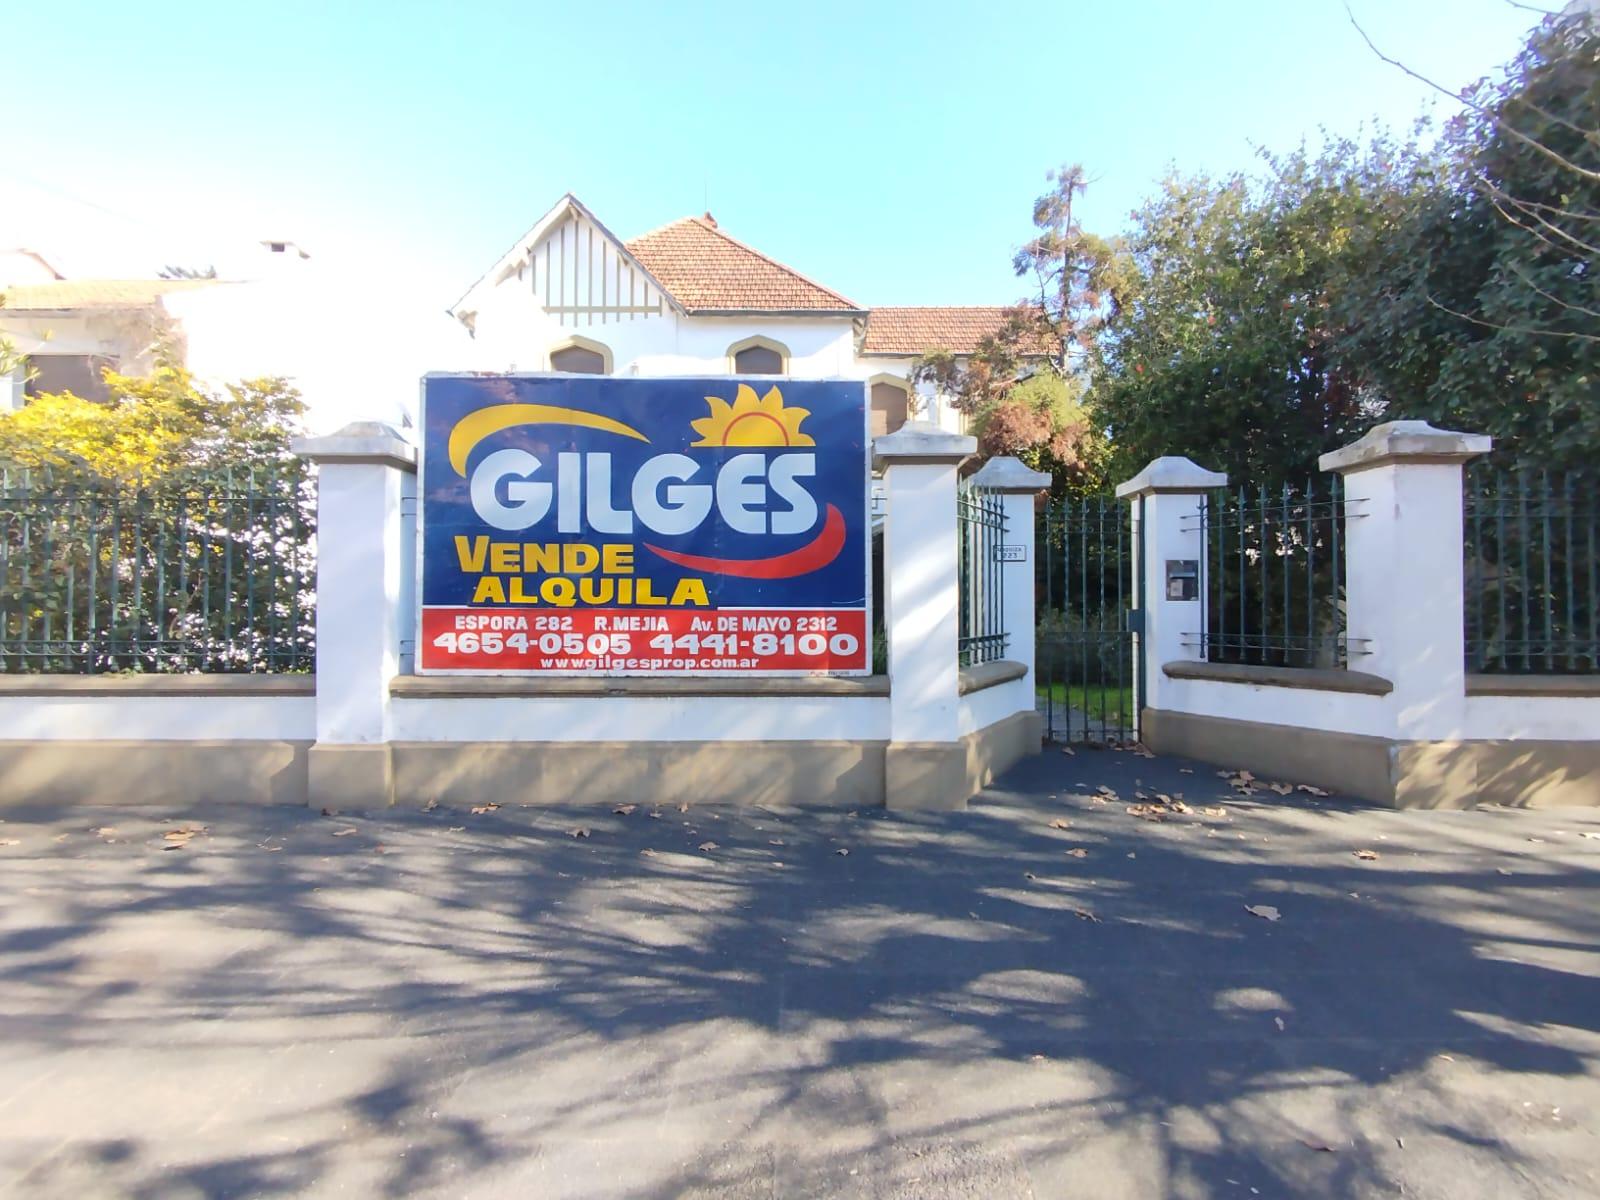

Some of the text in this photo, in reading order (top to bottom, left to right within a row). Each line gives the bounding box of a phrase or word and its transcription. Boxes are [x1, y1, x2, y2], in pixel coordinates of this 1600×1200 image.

[470, 448, 818, 536] GILGES
[454, 535, 634, 574] VENDE
[472, 576, 710, 608] ALQUILA
[455, 615, 529, 630] ESPORA
[535, 616, 574, 631] 282
[594, 616, 669, 631] R.MEJIA
[717, 616, 738, 632] DE
[742, 616, 791, 632] MAYO
[796, 616, 837, 631] 2312
[433, 632, 859, 656] 4654-0505 4441-8100
[540, 655, 760, 671] www.gilgesprop.com.ar
